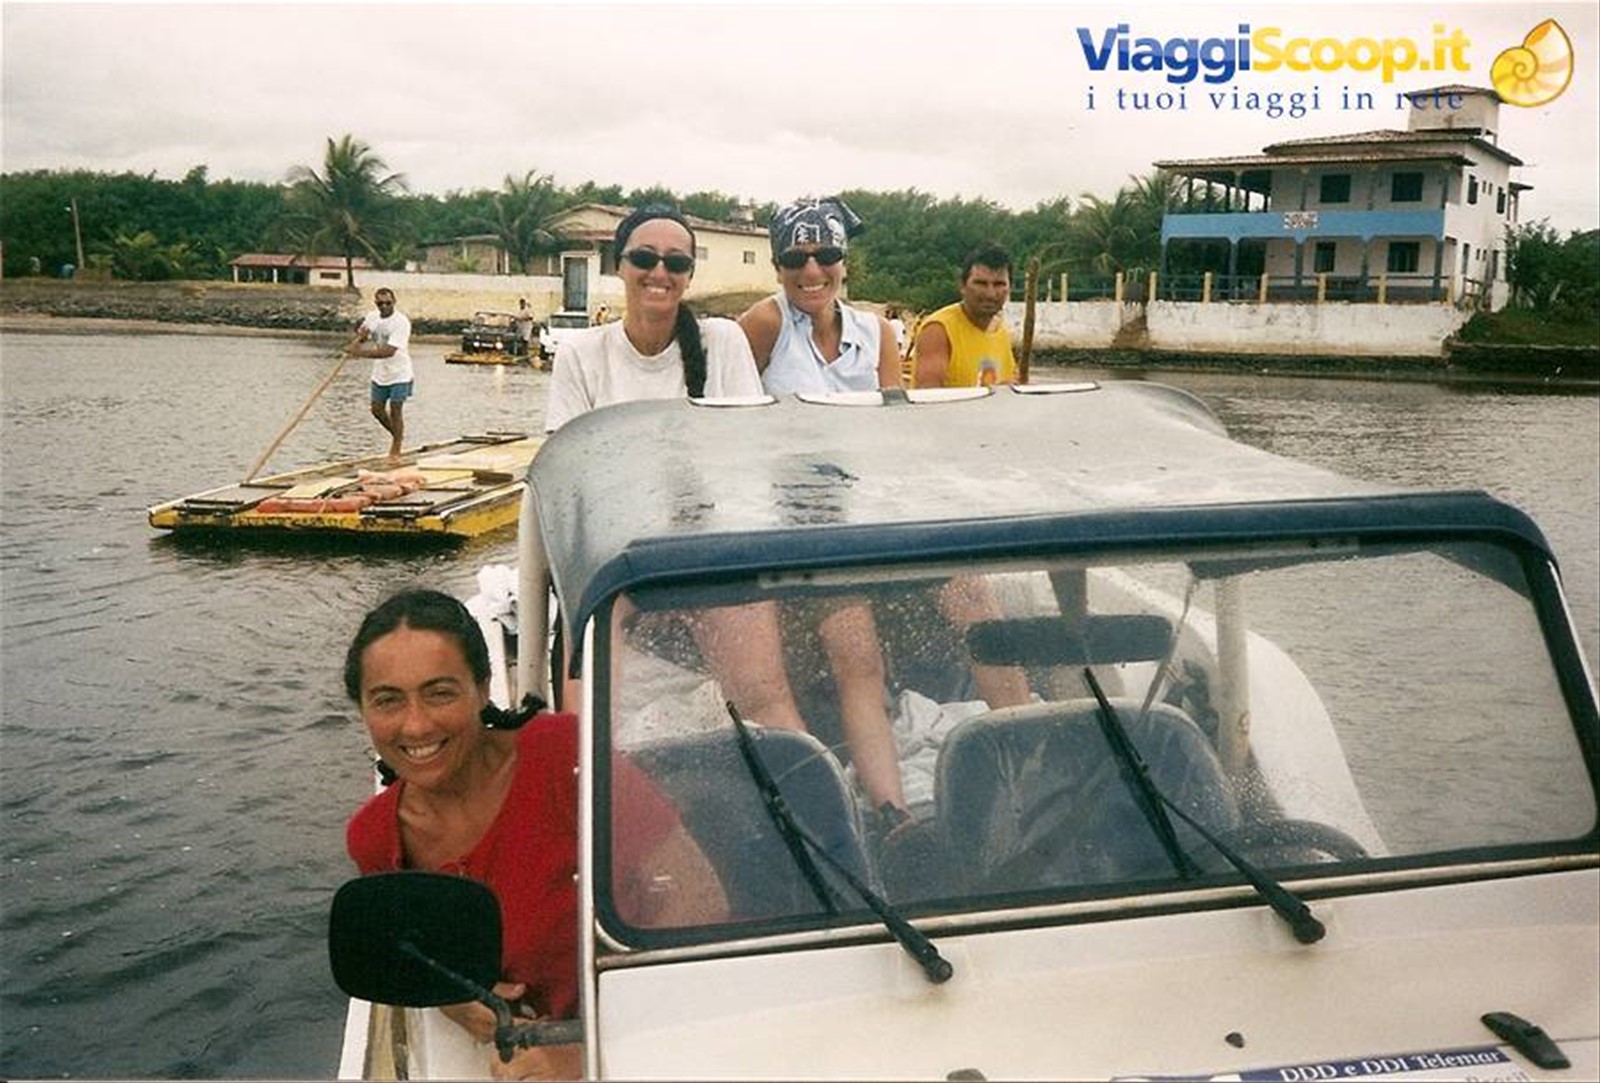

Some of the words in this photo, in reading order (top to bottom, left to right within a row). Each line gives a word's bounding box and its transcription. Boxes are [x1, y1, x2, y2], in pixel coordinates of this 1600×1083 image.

[1280, 1064, 1338, 1081] DDD
[1344, 1065, 1358, 1075] e
[1362, 1057, 1410, 1074] DDI
[1411, 1051, 1500, 1068] Telemar
